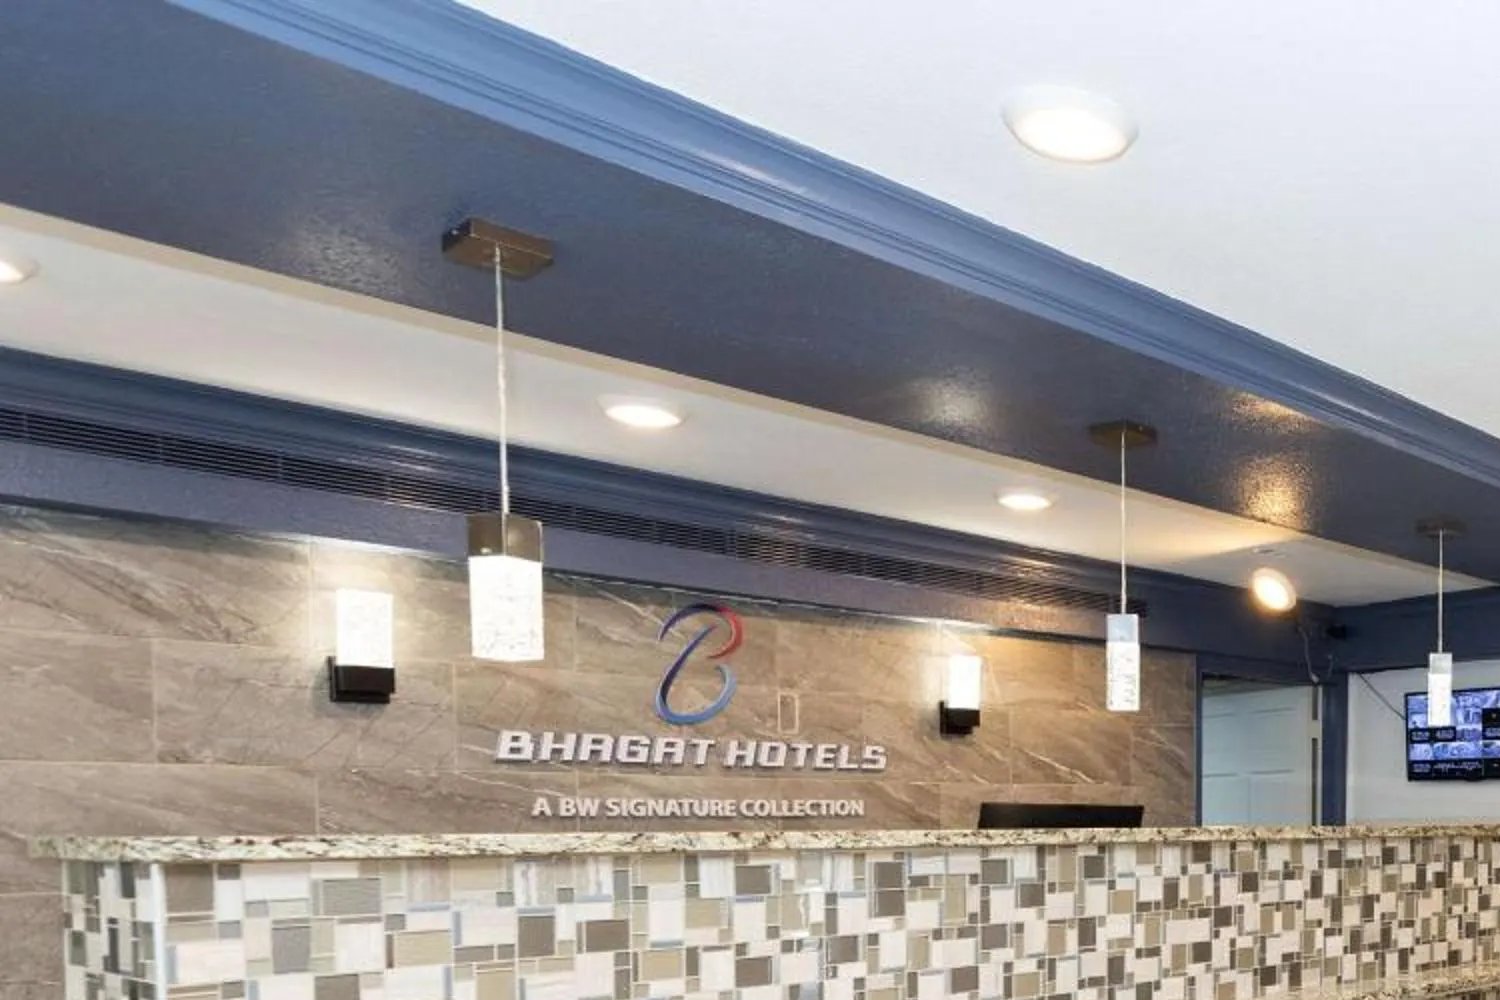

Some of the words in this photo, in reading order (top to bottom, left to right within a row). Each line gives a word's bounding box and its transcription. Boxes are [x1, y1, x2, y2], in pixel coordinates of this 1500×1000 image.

[496, 730, 716, 766] BHAGAT
[722, 739, 888, 770] HOTELS
[531, 797, 553, 818] A
[558, 797, 601, 818] BW
[605, 798, 737, 818] SIGNATURE
[738, 799, 865, 818] COLLECTION
